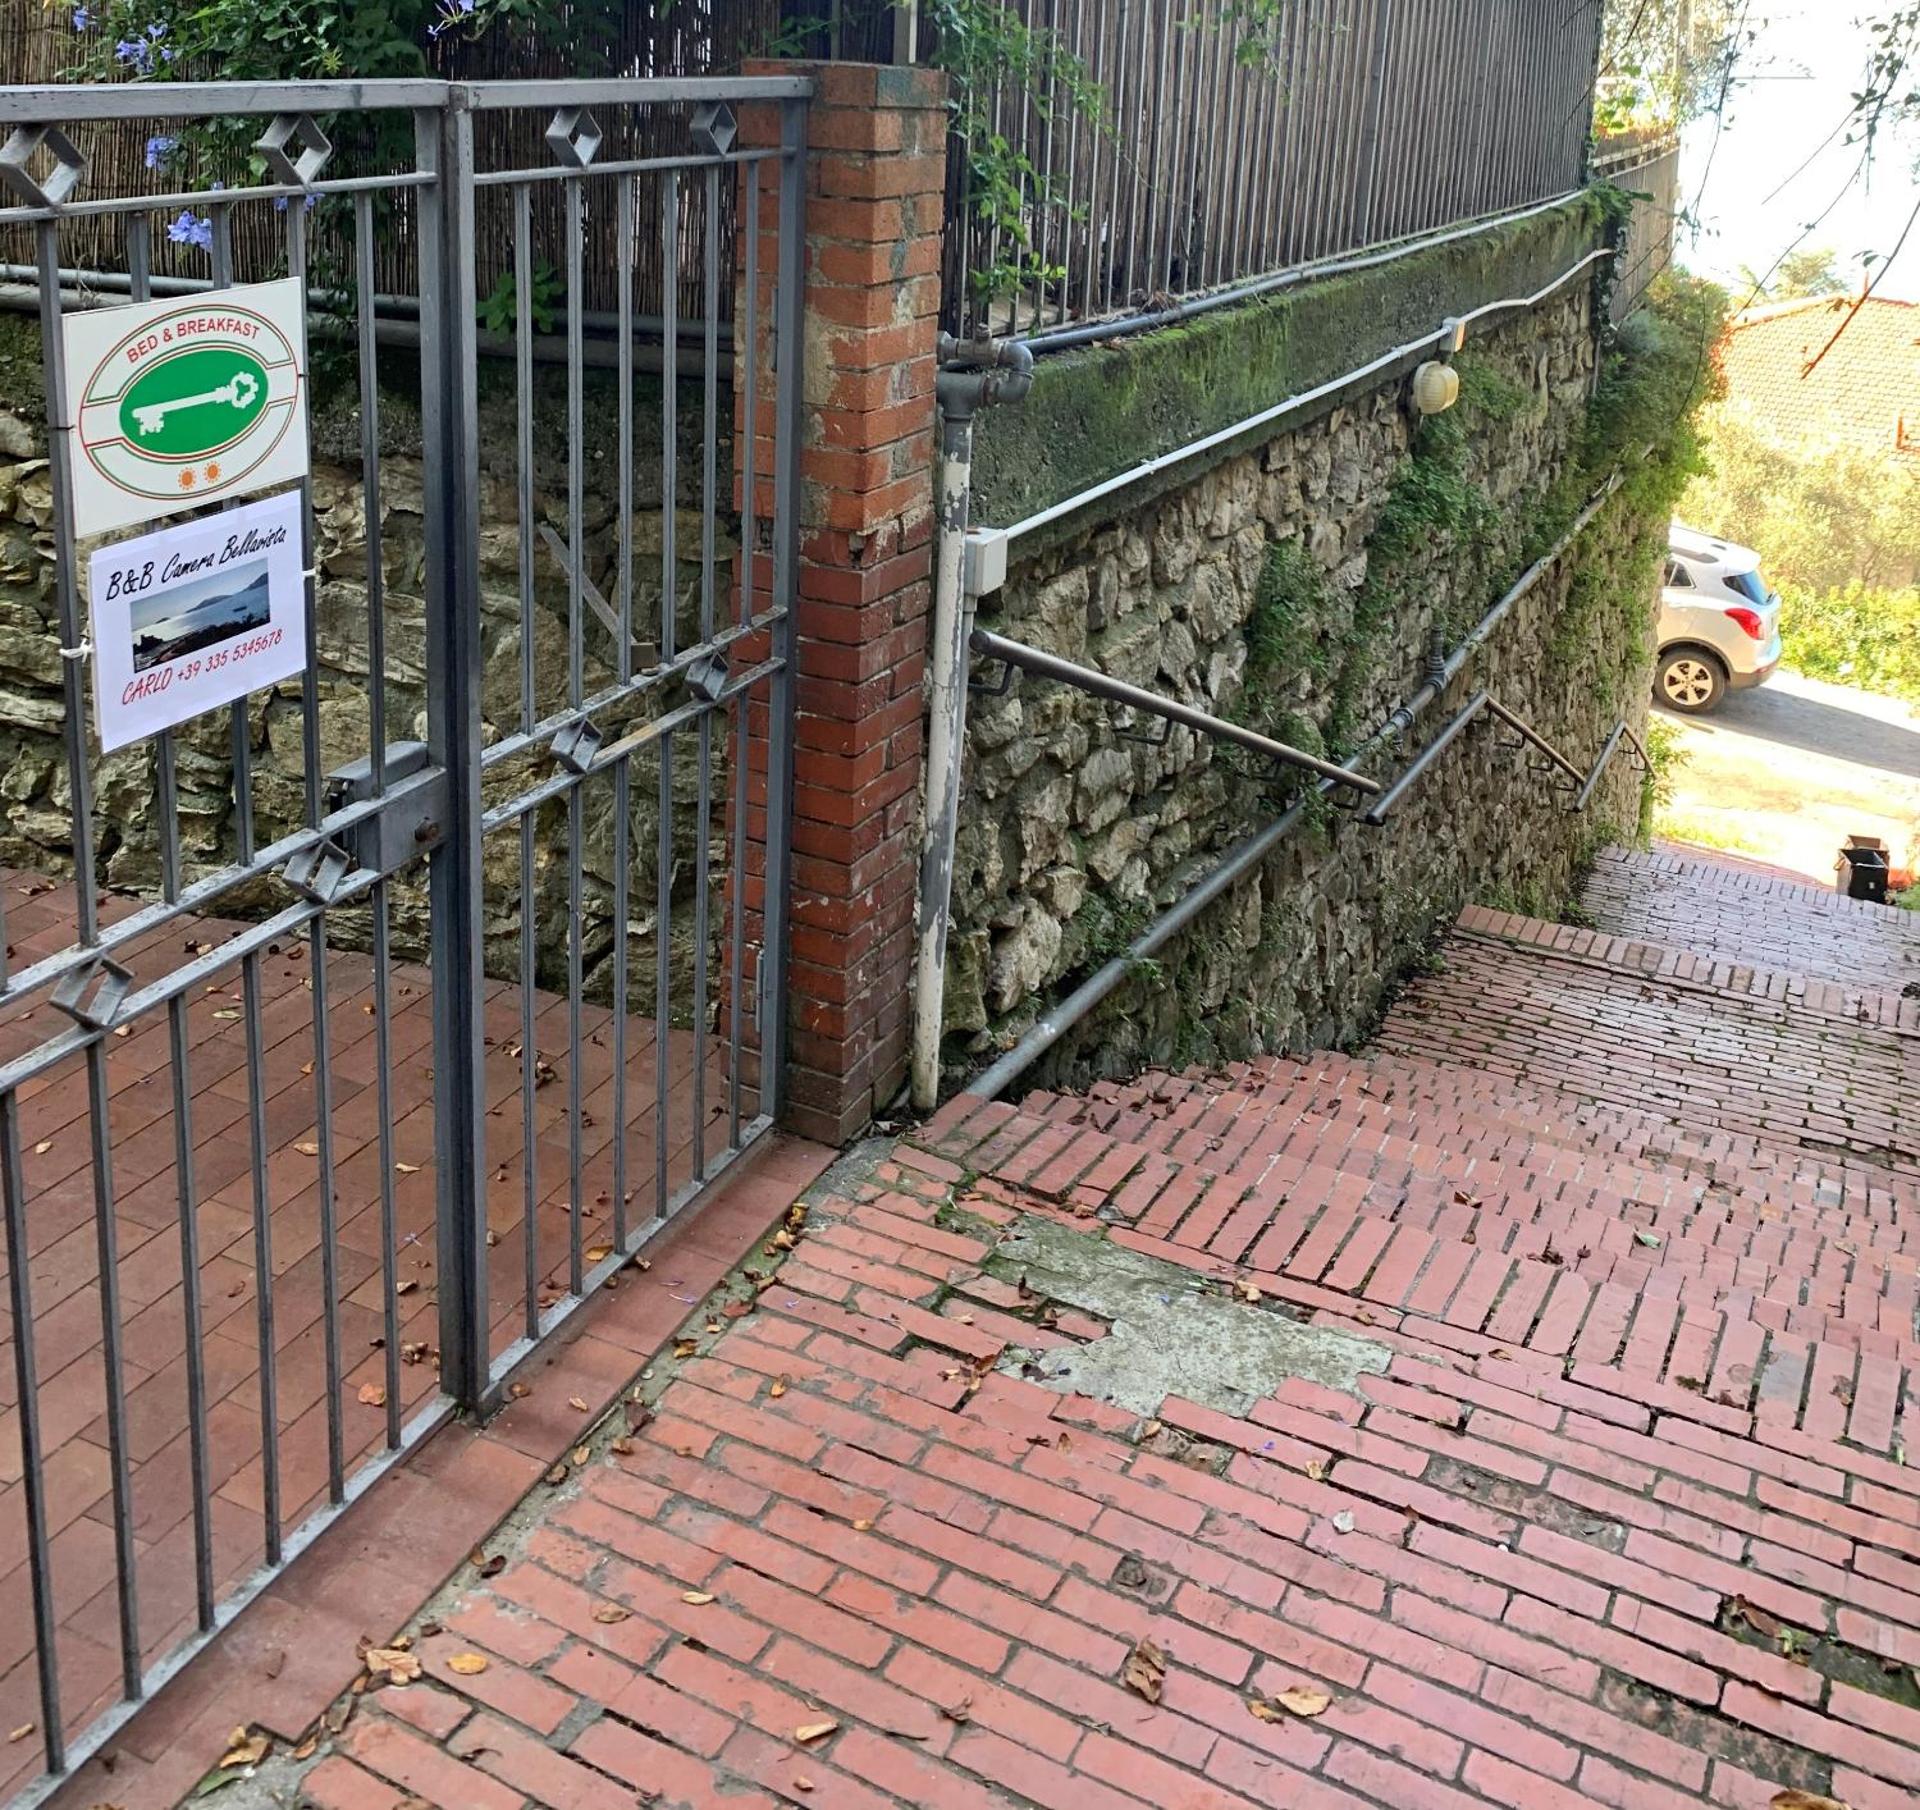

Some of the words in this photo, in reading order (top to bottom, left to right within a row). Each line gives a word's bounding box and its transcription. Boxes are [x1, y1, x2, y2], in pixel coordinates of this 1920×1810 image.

[126, 334, 158, 363] BED
[163, 328, 173, 342] &
[177, 318, 260, 339] BREAKFAST
[106, 561, 155, 600] B&B
[161, 553, 215, 583] Camera
[219, 525, 287, 564] Bellavista
[122, 667, 173, 705] CARLO
[177, 660, 201, 681] +39
[205, 650, 228, 672] 335
